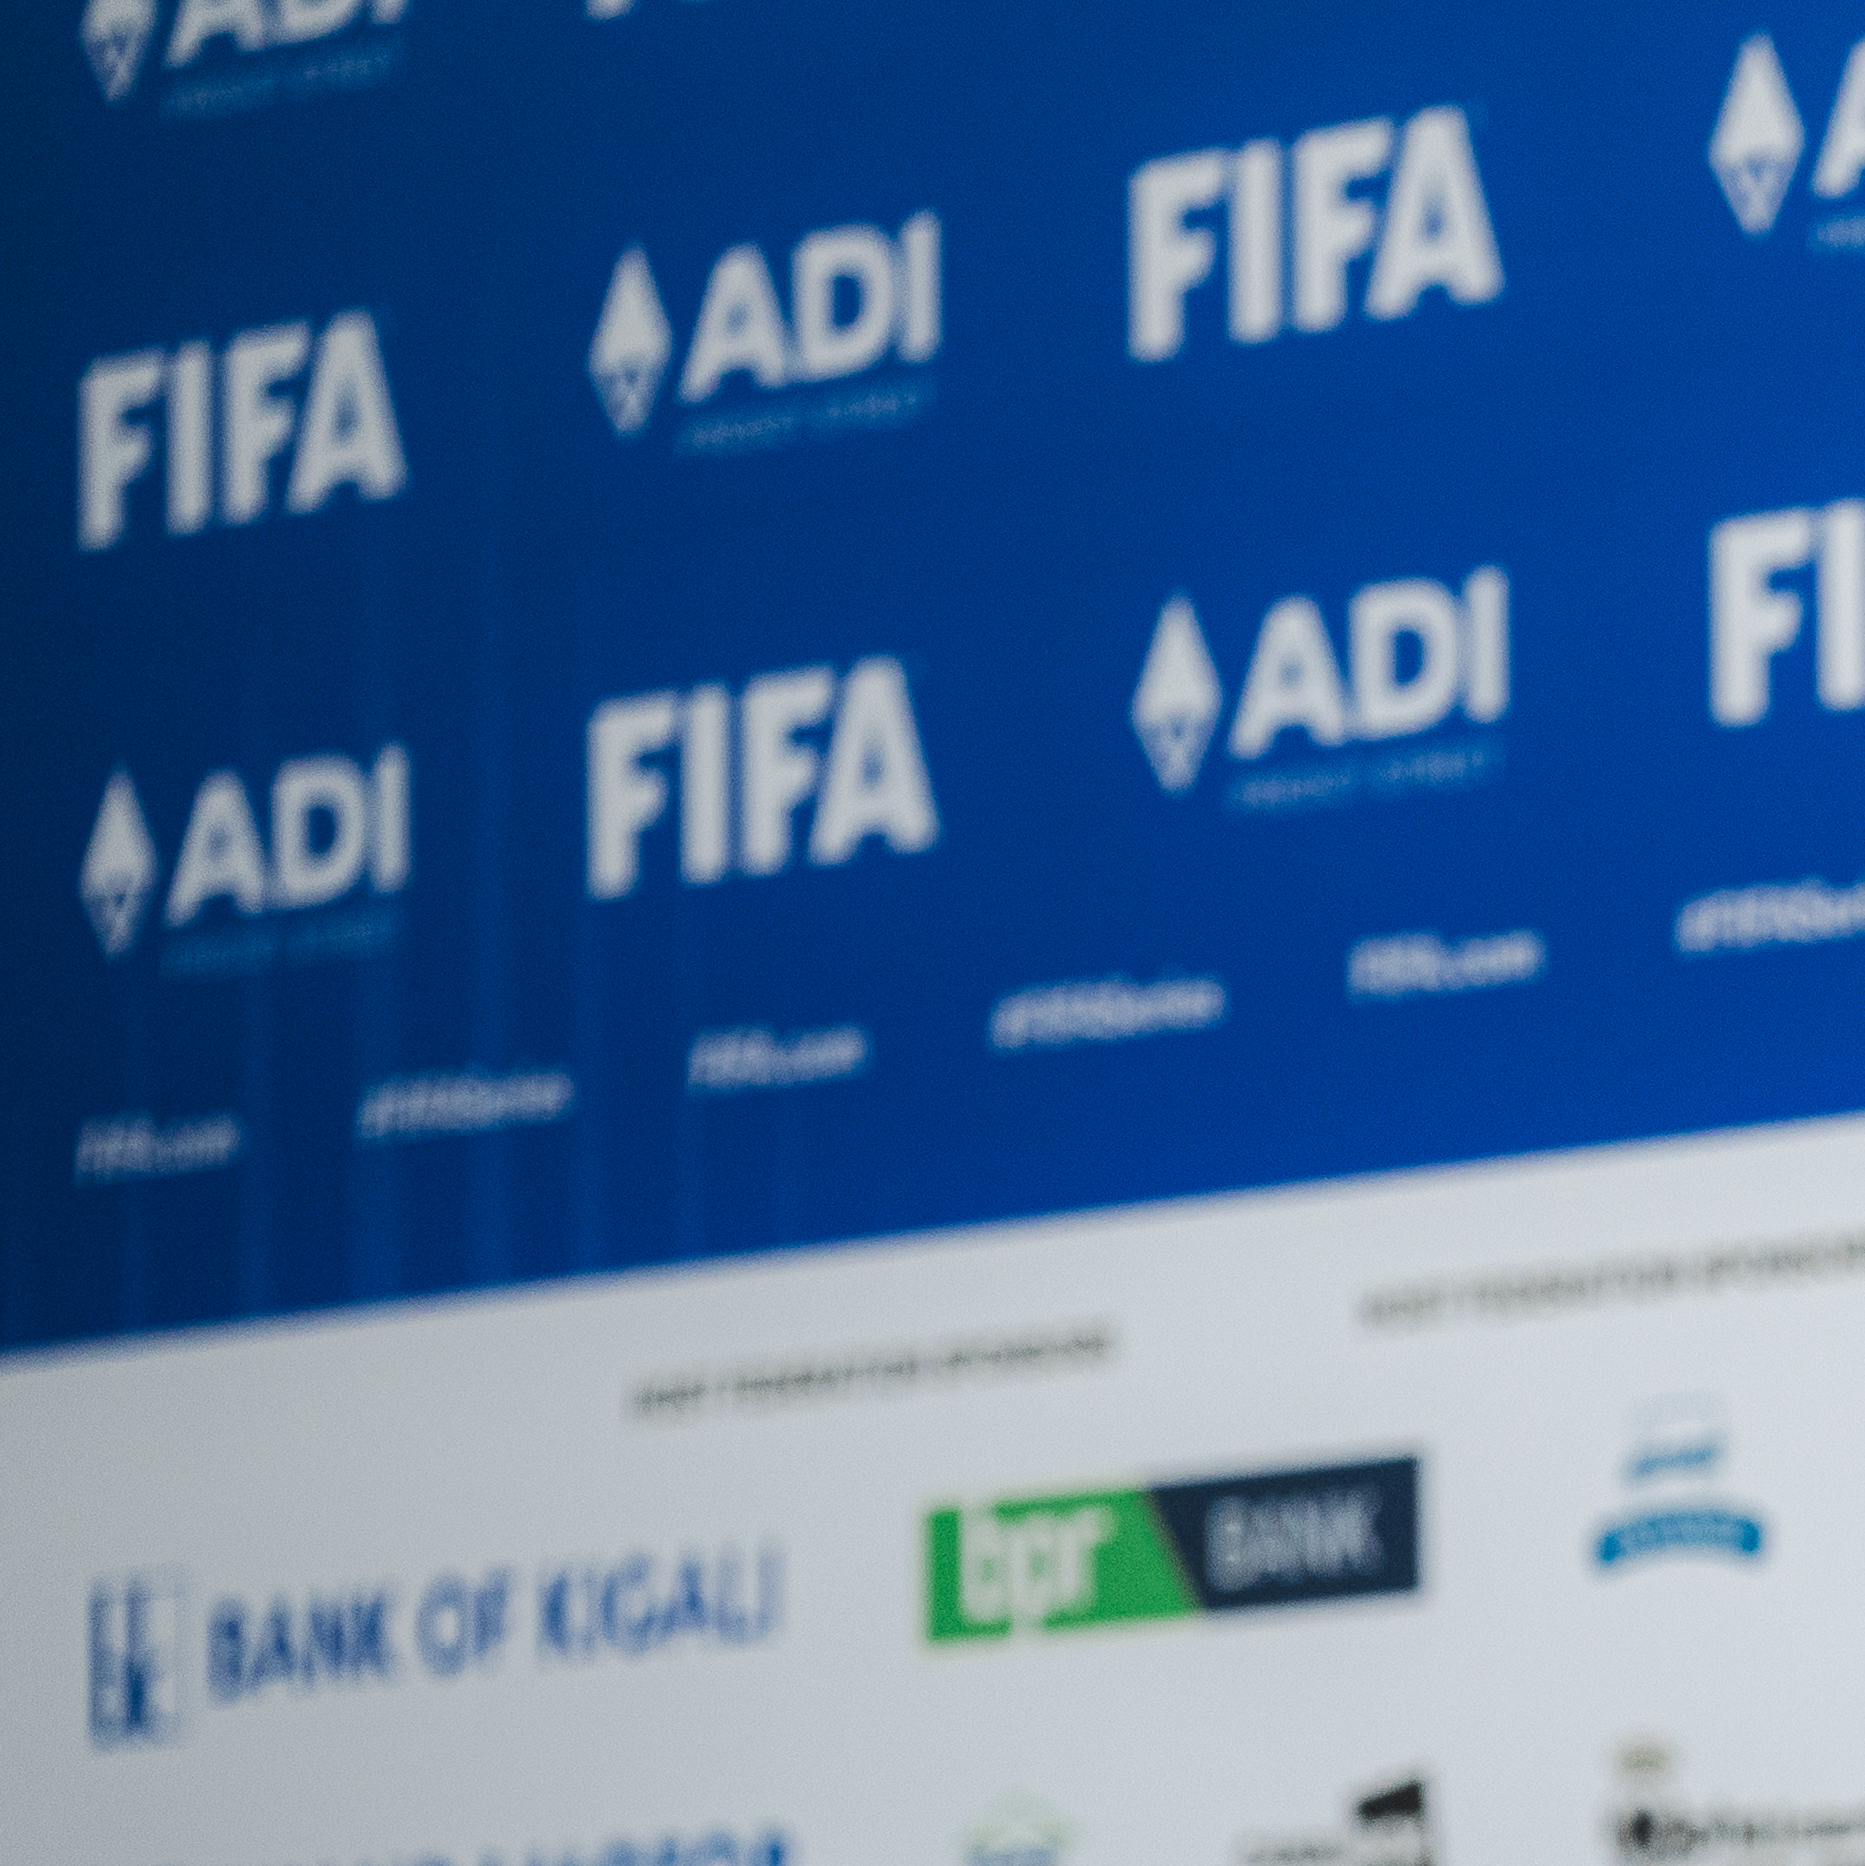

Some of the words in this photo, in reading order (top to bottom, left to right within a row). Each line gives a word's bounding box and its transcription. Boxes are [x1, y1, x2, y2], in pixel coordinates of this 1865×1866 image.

[682, 212, 941, 400] ADI
[1130, 106, 1502, 360] FIFA
[81, 310, 405, 549] FIFA
[1230, 566, 1509, 759] ADI
[166, 744, 409, 925] ADI
[587, 656, 938, 898] FIFA
[207, 1578, 395, 1704] BANK
[415, 1562, 512, 1676] OF
[535, 1534, 783, 1660] KIGALI
[1205, 1482, 1384, 1594] BANK
